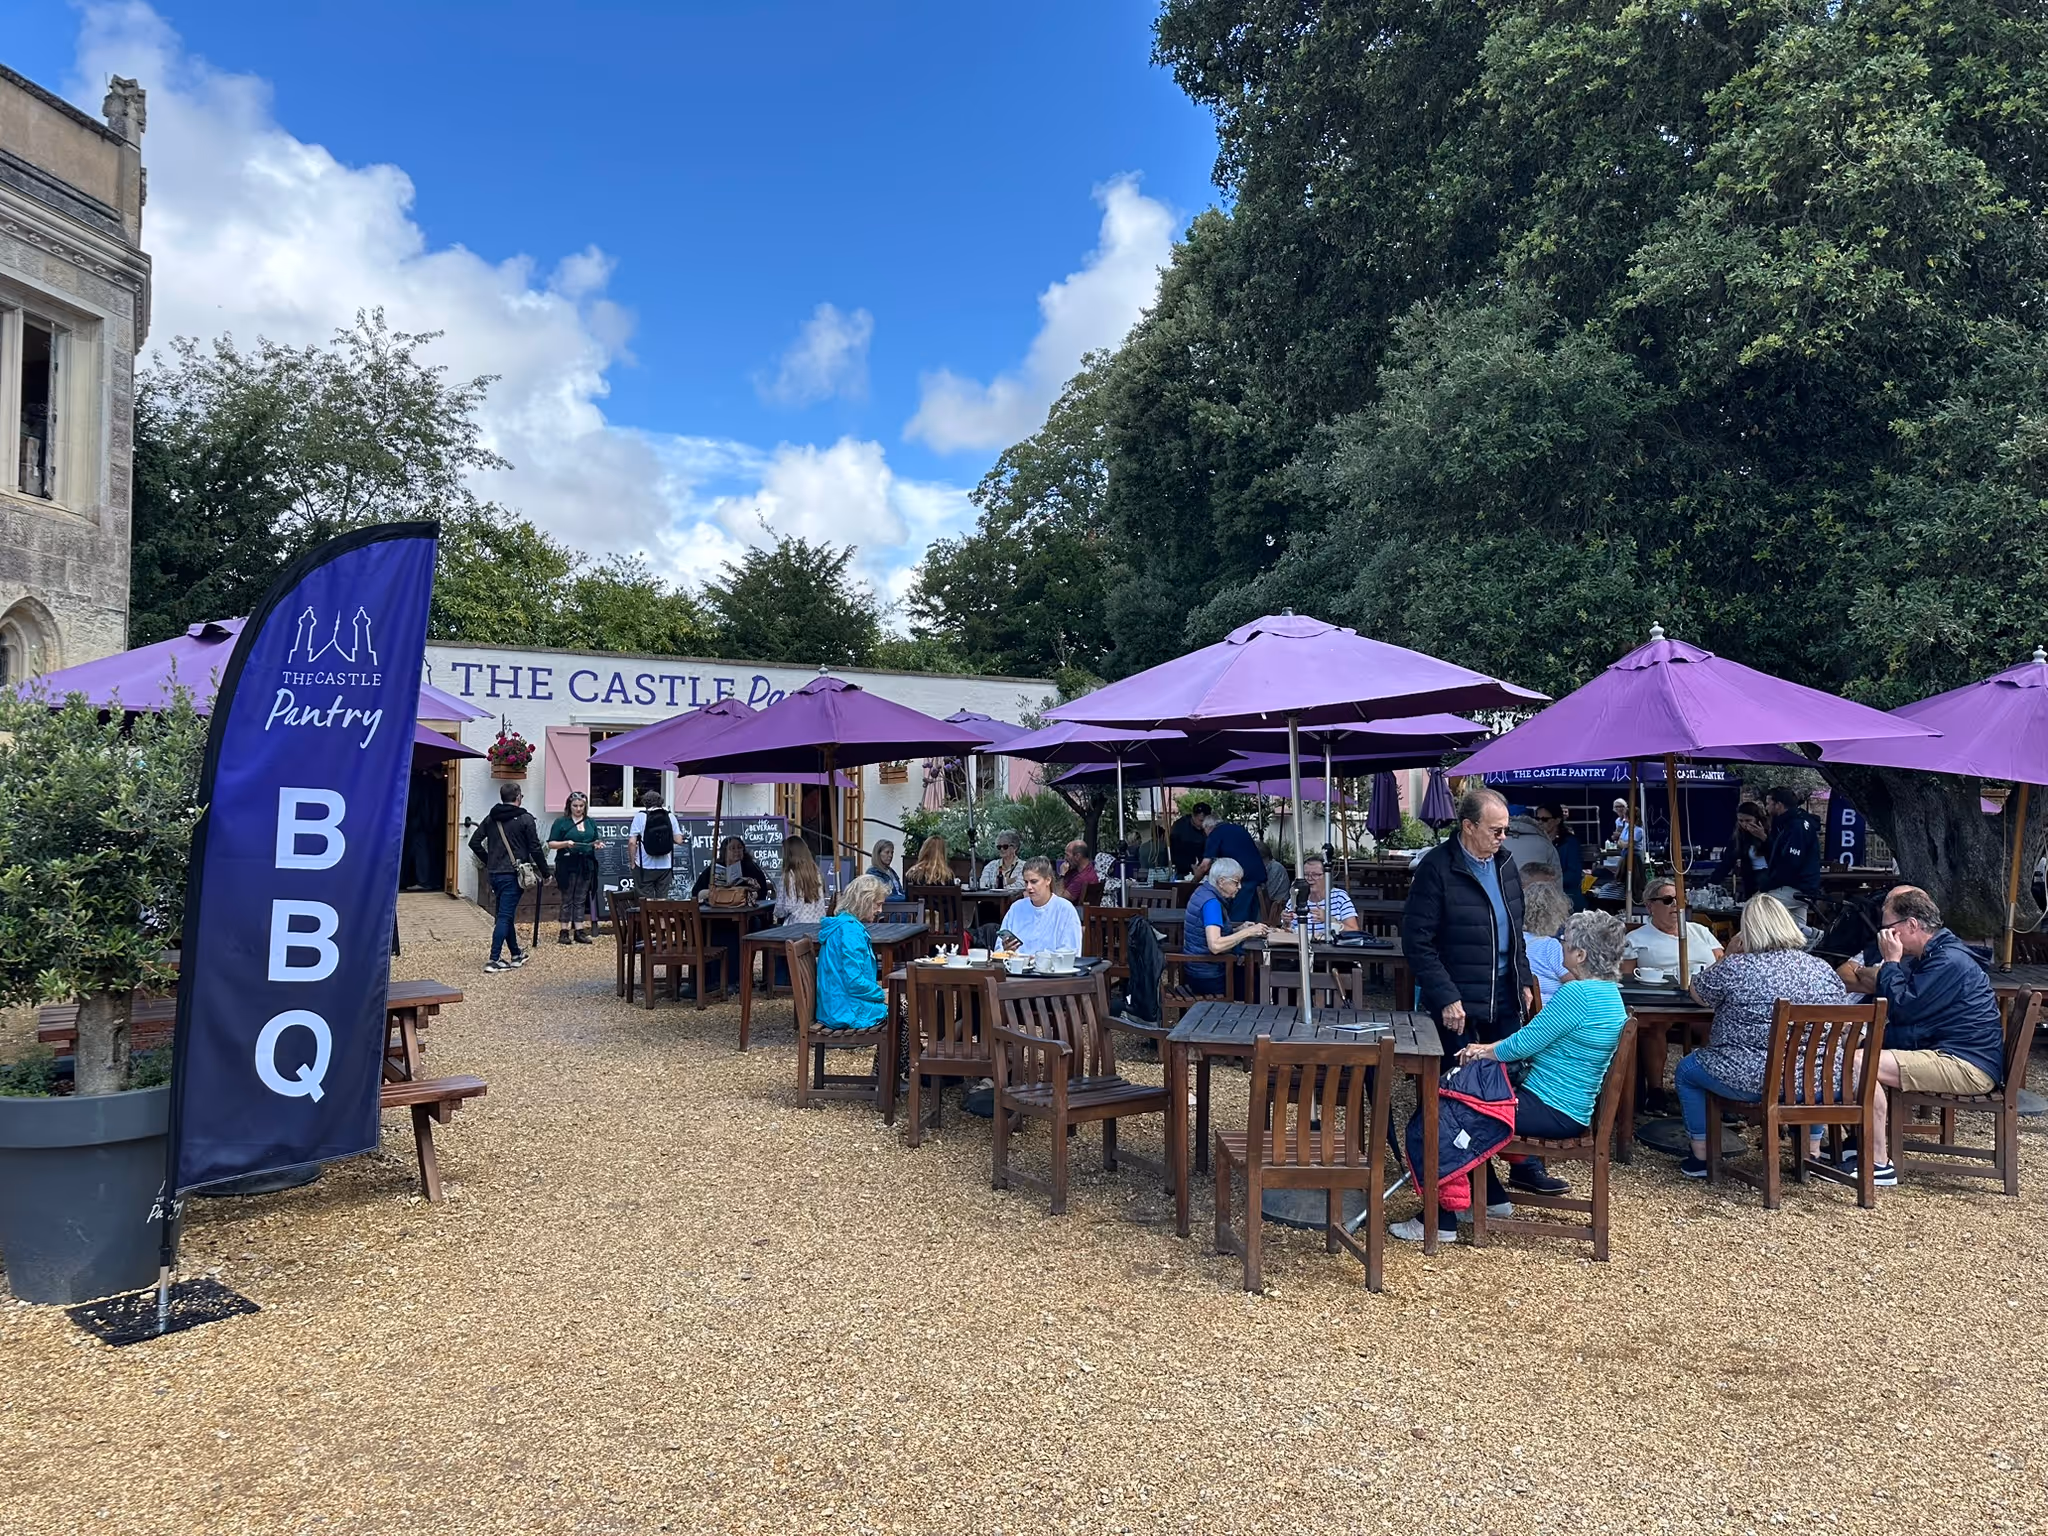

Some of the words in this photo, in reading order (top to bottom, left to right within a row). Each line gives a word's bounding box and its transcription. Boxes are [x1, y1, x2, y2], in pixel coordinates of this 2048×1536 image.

[451, 662, 553, 701] THE
[568, 669, 734, 707] CASTLE
[264, 687, 383, 749] Pantry
[1513, 770, 1532, 779] THE
[1532, 768, 1567, 778] CASTLE
[1568, 768, 1607, 777] PANTRY
[748, 824, 779, 832] BEVERAGE
[749, 833, 764, 841] CAKE
[753, 850, 779, 859] CREAM
[254, 786, 346, 1103] BBQ
